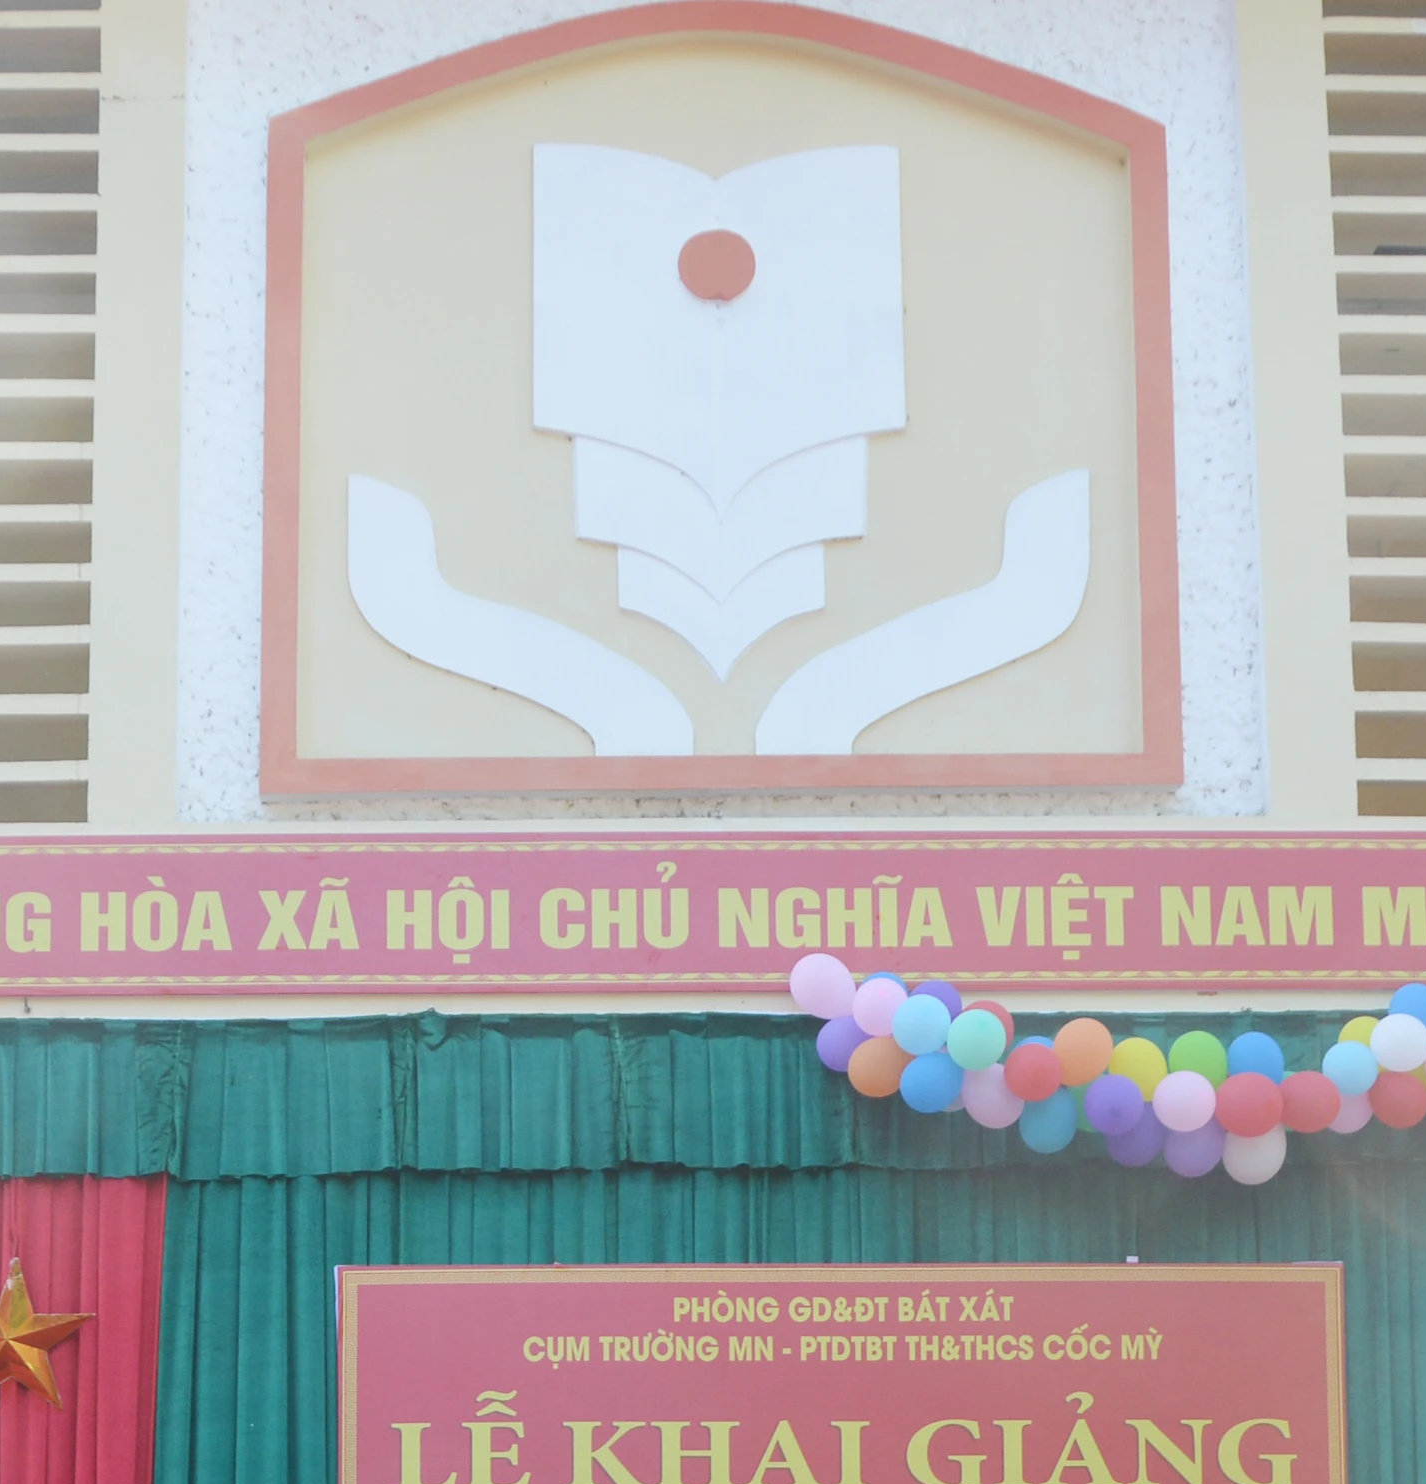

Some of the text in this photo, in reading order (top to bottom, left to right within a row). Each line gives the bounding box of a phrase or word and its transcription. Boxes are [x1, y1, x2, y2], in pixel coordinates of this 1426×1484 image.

[81, 876, 232, 952] HÒA
[259, 878, 359, 949] XÃ
[387, 877, 509, 963] HỘI
[540, 862, 689, 949] CHỦ
[719, 876, 952, 948] NGHĨA
[977, 874, 1134, 960] VIỆT
[1161, 886, 1333, 945] NAM
[675, 1290, 1014, 1322] PHÒNG GD&ĐT BÁT XÁT
[524, 1337, 590, 1368] CỤM
[600, 1330, 719, 1361] TRƯỜNG
[730, 1337, 773, 1361] MN
[801, 1336, 897, 1360] PTDTBT
[906, 1335, 1034, 1360] TH&THCS
[1043, 1324, 1111, 1361] CỐC
[1120, 1328, 1162, 1360] MỲ
